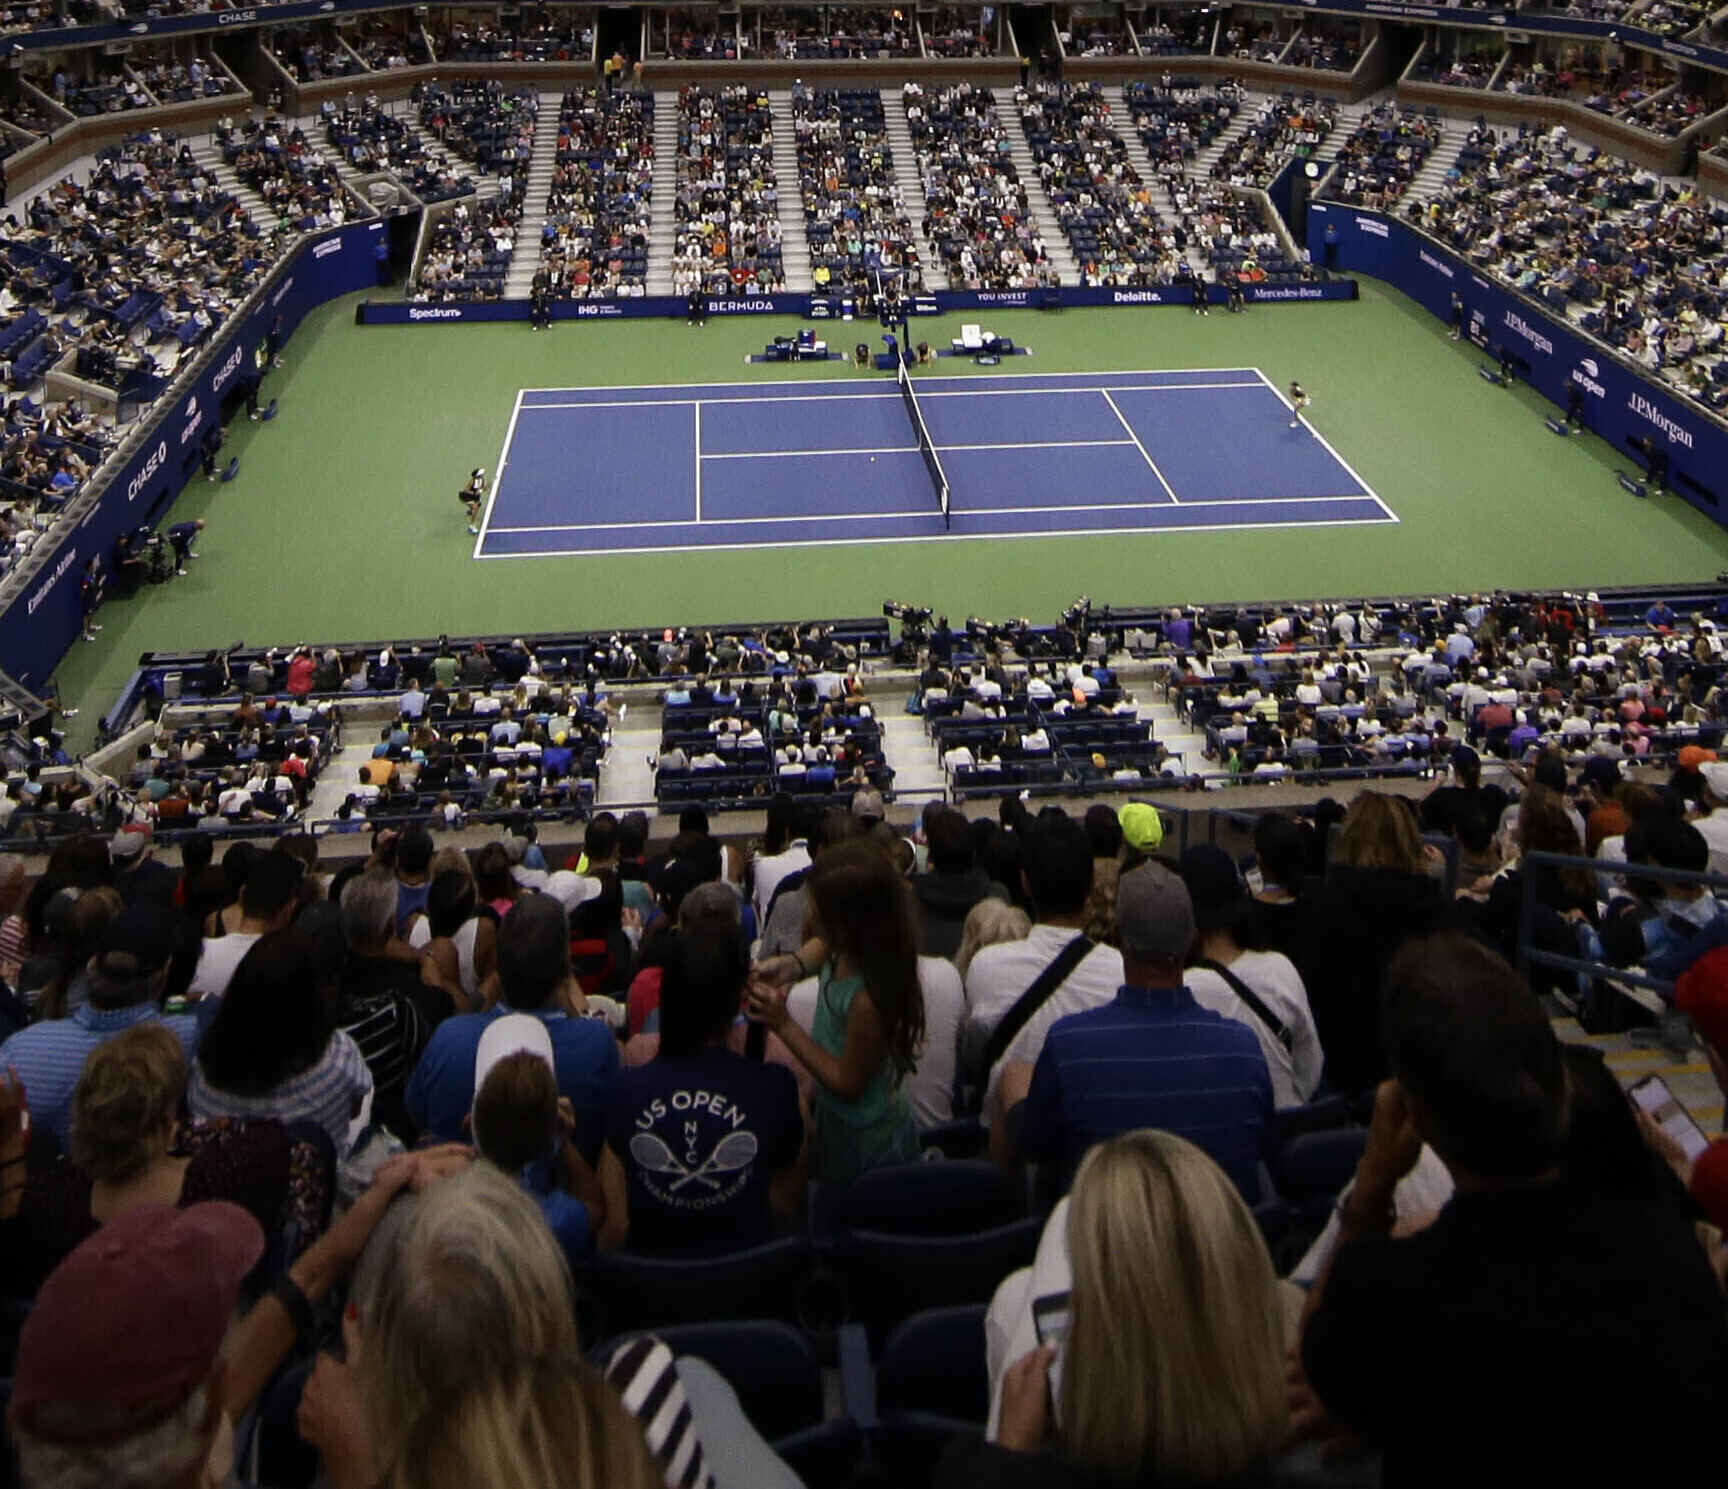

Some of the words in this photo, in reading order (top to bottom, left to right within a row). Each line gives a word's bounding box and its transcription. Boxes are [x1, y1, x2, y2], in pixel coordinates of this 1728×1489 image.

[218, 10, 257, 25] CHASE
[977, 293, 996, 302] YOU
[997, 292, 1027, 302] INVEST
[1113, 291, 1162, 302] Deloitte.
[1254, 288, 1323, 299] Mercedes-Benz
[578, 305, 598, 315] IHG
[708, 301, 774, 312] BERMUDA
[409, 308, 456, 319] Spectrum
[1504, 310, 1553, 354] J.P.Morgan
[213, 355, 237, 392] CHASE
[1627, 392, 1693, 449] J.P.Morgan
[128, 450, 159, 501] CHASE
[635, 1098, 667, 1130] US
[671, 1089, 747, 1129] OPEN
